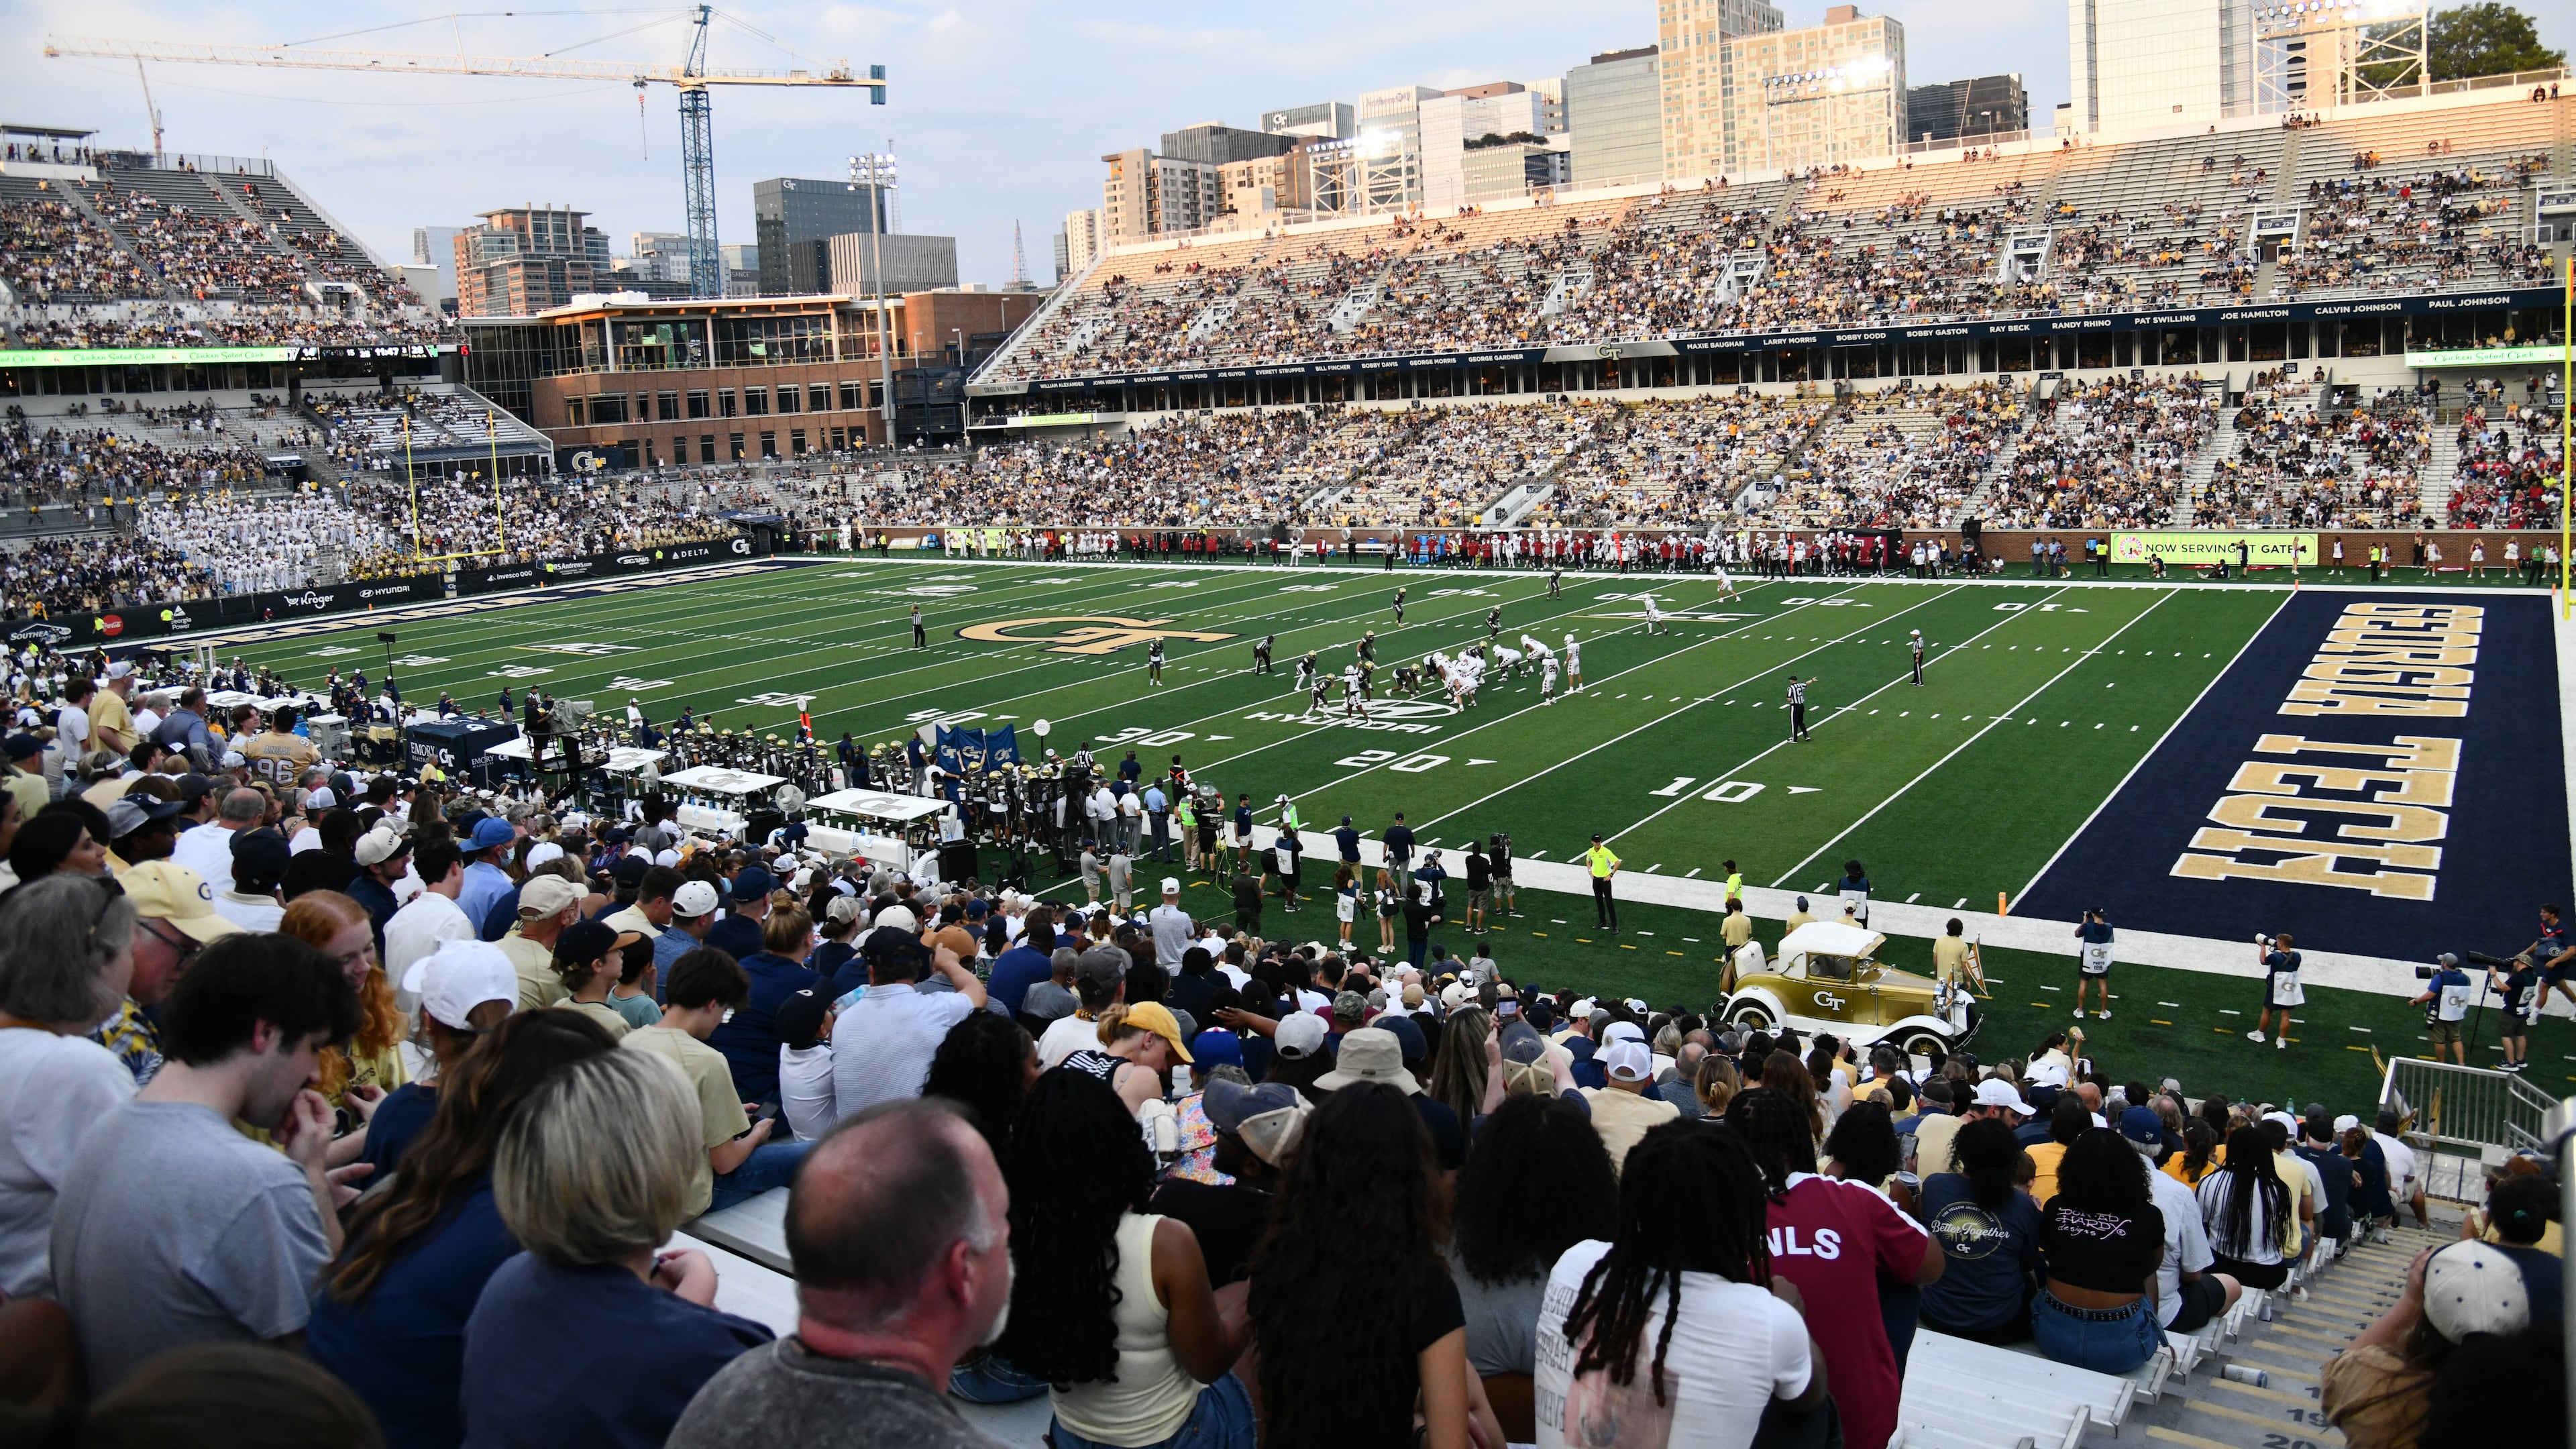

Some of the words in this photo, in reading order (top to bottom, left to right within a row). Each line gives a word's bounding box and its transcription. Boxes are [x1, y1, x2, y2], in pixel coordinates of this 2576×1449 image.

[783, 179, 796, 191] GT
[2315, 306, 2351, 315] CALVIN
[2353, 303, 2402, 313] JOHNSON
[2428, 300, 2455, 309] PAUL
[2458, 297, 2510, 307] JOHNSON
[2153, 315, 2196, 323] SWILLING
[2220, 312, 2239, 320] JOE
[2241, 310, 2289, 319] HAMILTON
[2008, 324, 2030, 332] BECK
[2052, 321, 2082, 329] RANDY
[2084, 319, 2112, 328] RHINO
[1935, 328, 1968, 336] GASTON
[134, 353, 156, 361] Chick
[374, 347, 399, 357] 11:47
[1595, 343, 1622, 361] GT
[2434, 354, 2473, 364] Chicken
[2507, 351, 2534, 360] Chick
[13, 356, 36, 364] Chick
[572, 451, 606, 475] GT
[681, 548, 709, 558] DELTA
[732, 539, 751, 555] GT
[2146, 544, 2177, 553] NOW
[2182, 543, 2237, 554] SERVING
[2261, 544, 2294, 554] GATE
[623, 557, 649, 565] SCANA
[496, 572, 520, 580] Invesco
[375, 586, 410, 596] HYUNDAI
[301, 591, 334, 609] Kroger
[10, 631, 51, 641] SOUTHEA
[955, 616, 1242, 655] GT
[2276, 602, 2485, 717] GEORGIA
[1242, 711, 1443, 734] HYUNDAI
[1094, 727, 1195, 747] 30
[360, 743, 372, 759] GT
[410, 741, 435, 757] EMORY
[941, 745, 957, 759] GT
[962, 745, 982, 759] GT
[994, 747, 1013, 761] GT
[439, 748, 455, 767] GT
[472, 755, 494, 765] EMORY
[1333, 749, 1451, 773] 20
[257, 758, 294, 785] 96
[697, 773, 749, 788] GT
[1648, 777, 1766, 803] 10
[849, 797, 910, 814] GT
[2169, 733, 2463, 902] TECH
[2090, 948, 2107, 961] GT
[1812, 990, 1847, 1012] GT
[2448, 996, 2465, 1009] GT
[1982, 1210, 1995, 1222] FAMILY
[1931, 1220, 1962, 1234] Better
[1962, 1222, 2010, 1240] Together
[2055, 1215, 2132, 1240] HARDY
[2057, 1224, 2096, 1236] designs
[1768, 1226, 1841, 1260] LS
[1956, 1243, 1971, 1254] GT
